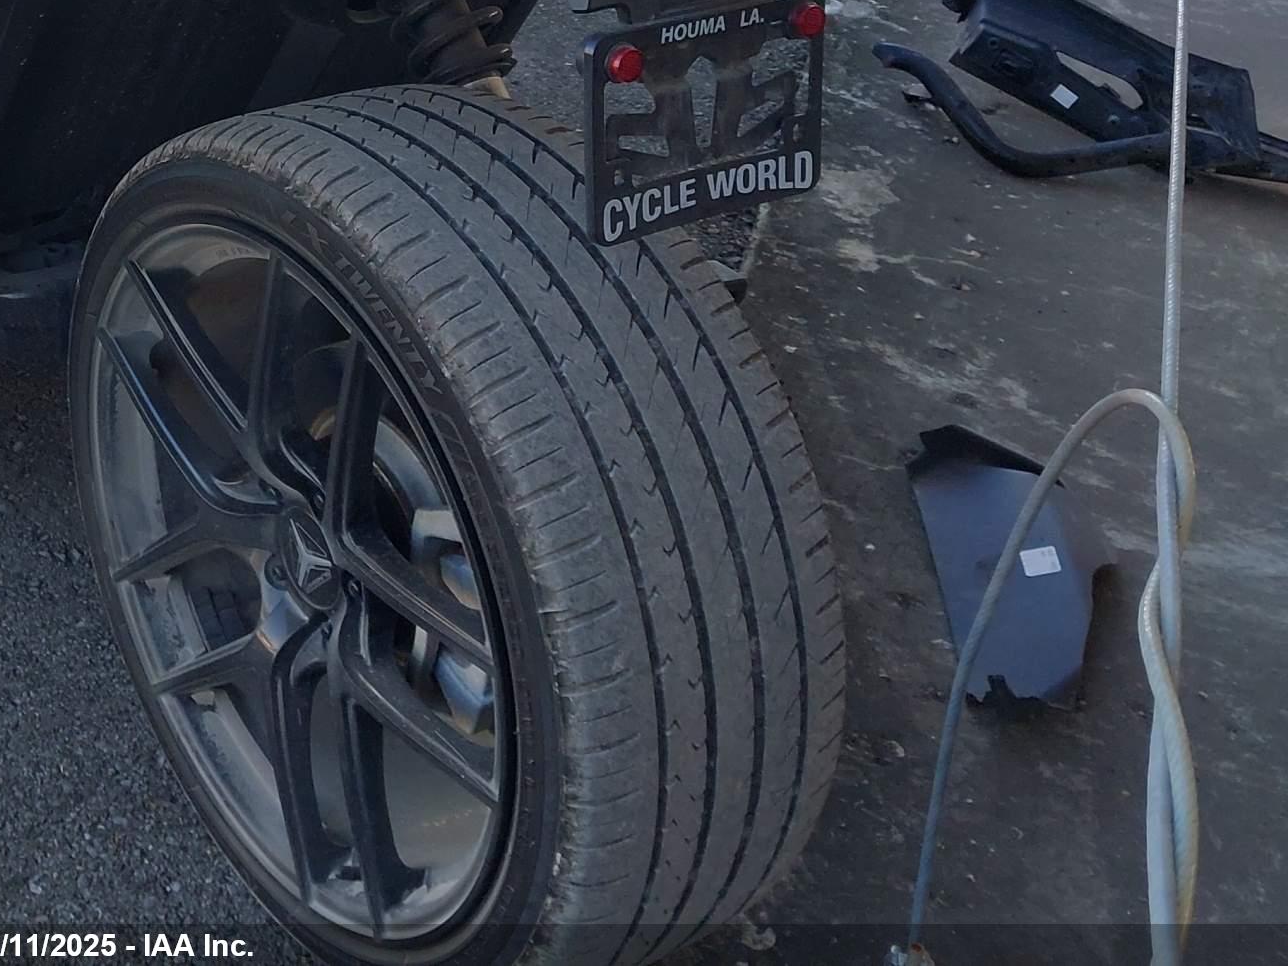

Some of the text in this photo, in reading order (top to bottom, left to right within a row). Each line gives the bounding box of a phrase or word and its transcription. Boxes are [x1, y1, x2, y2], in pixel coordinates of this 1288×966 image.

[661, 7, 765, 45] HOUMA LA.
[603, 149, 814, 243] CYCLE WORLD
